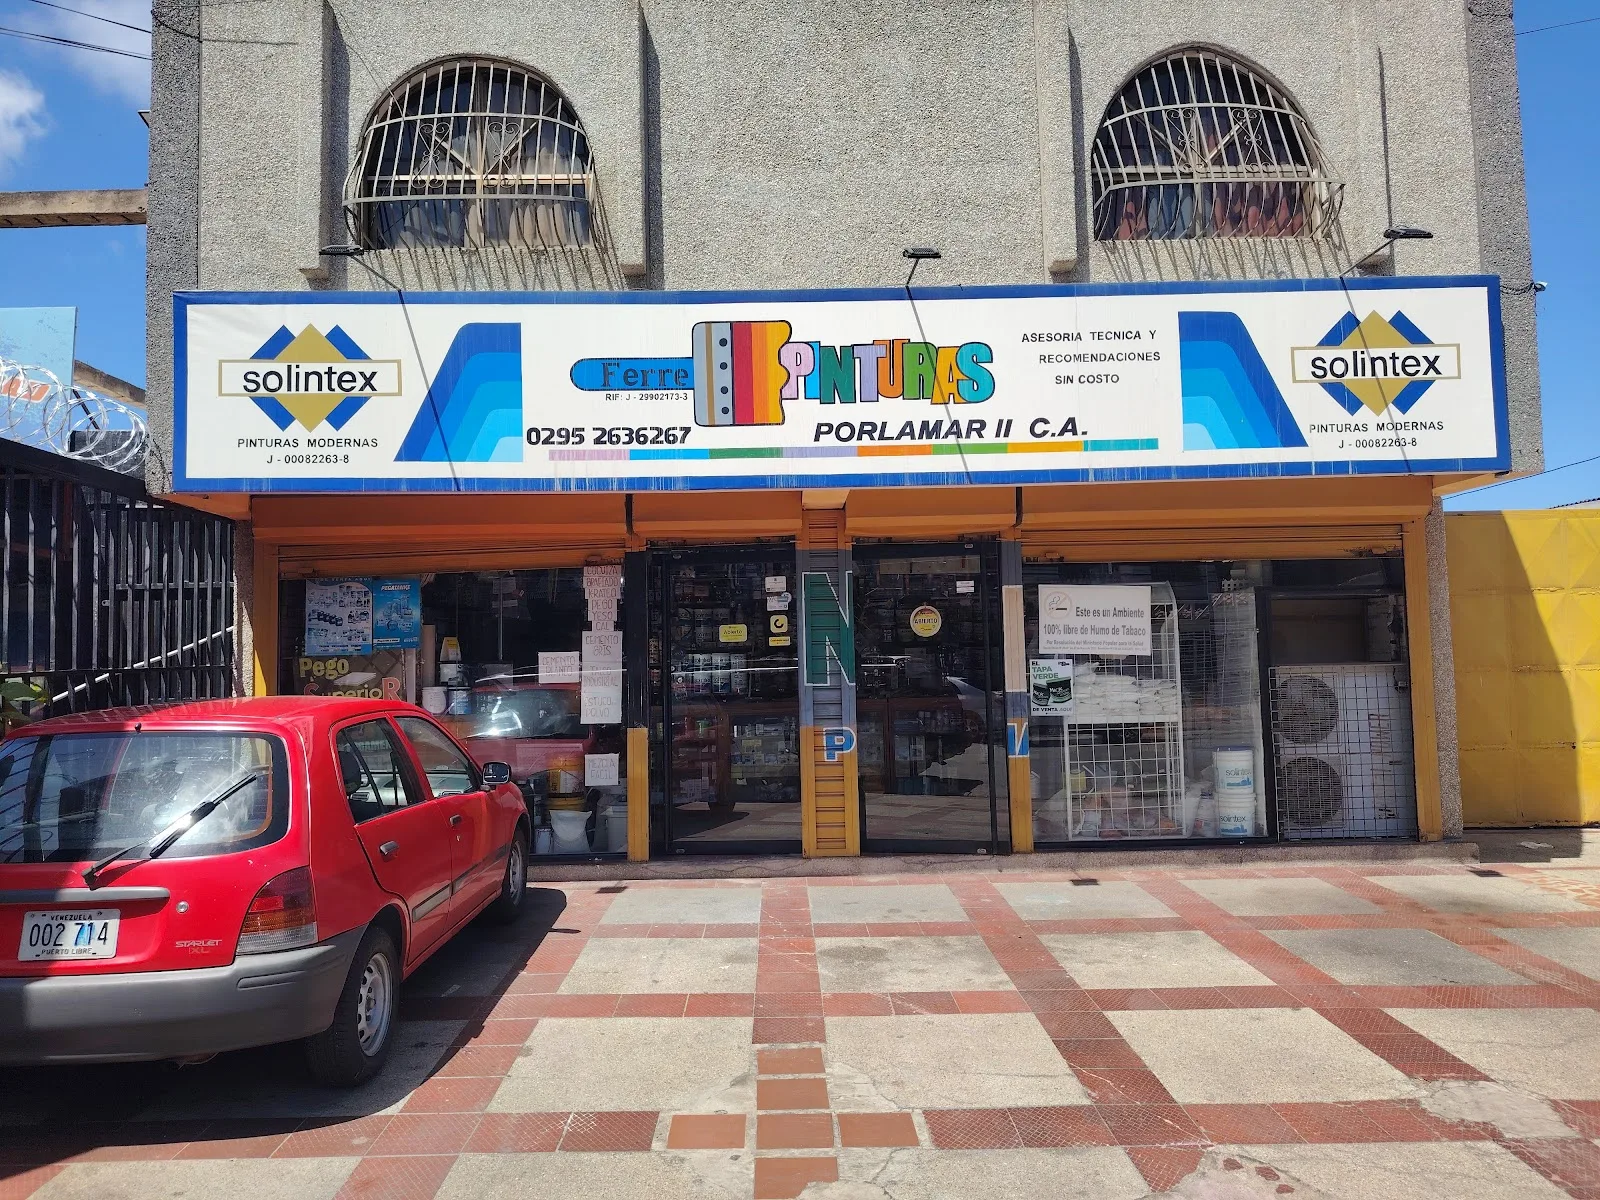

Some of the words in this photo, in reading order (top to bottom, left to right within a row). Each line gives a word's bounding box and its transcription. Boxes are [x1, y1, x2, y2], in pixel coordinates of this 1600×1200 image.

[1022, 331, 1082, 342] ASESORIA
[1090, 330, 1142, 342] TECNICA
[1149, 330, 1157, 339] Y
[1038, 352, 1161, 364] RECOMENDACIONES
[1310, 349, 1444, 380] solintex
[600, 362, 690, 388] Ferre
[779, 339, 996, 405] PINTURAS
[242, 364, 378, 394] solintex
[1054, 374, 1075, 385] SIN
[1078, 374, 1120, 384] COSTO
[606, 393, 624, 401] RIF:
[626, 393, 630, 401] J
[639, 392, 688, 401] 29902173-3
[814, 419, 987, 442] PORLAMAR
[994, 419, 1014, 438] II
[1029, 416, 1088, 438] C.A.
[1308, 422, 1368, 434] PINTURAS
[1376, 421, 1444, 432] MODERNAS
[237, 437, 300, 448] PINTURAS
[307, 436, 378, 448] MODERNAS
[526, 427, 586, 446] 0295
[592, 426, 692, 446] 2636267
[1338, 440, 1344, 449] J
[1355, 438, 1418, 449] 00082263-8
[266, 454, 274, 464] J
[284, 454, 350, 464] 00082263-8
[592, 599, 613, 610] PEGO
[592, 611, 613, 620] YESO
[1076, 606, 1090, 617] Este
[1092, 609, 1100, 618] es
[1102, 608, 1110, 617] un
[1112, 607, 1144, 618] Ambiente
[596, 622, 610, 630] CAL
[1044, 624, 1061, 635] 100%
[1064, 624, 1078, 634] libre
[1080, 625, 1088, 635] de
[1090, 625, 1109, 636] Humo
[1112, 625, 1120, 635] de
[1122, 626, 1146, 636] Tabaco
[585, 635, 619, 644] CEMENTO
[594, 645, 612, 656] GRIS
[542, 656, 576, 666] CEMENTO
[298, 658, 350, 680] Pego
[823, 726, 856, 762] P
[30, 922, 66, 947] 002
[74, 922, 108, 946] 714
[175, 939, 222, 948] STARLET
